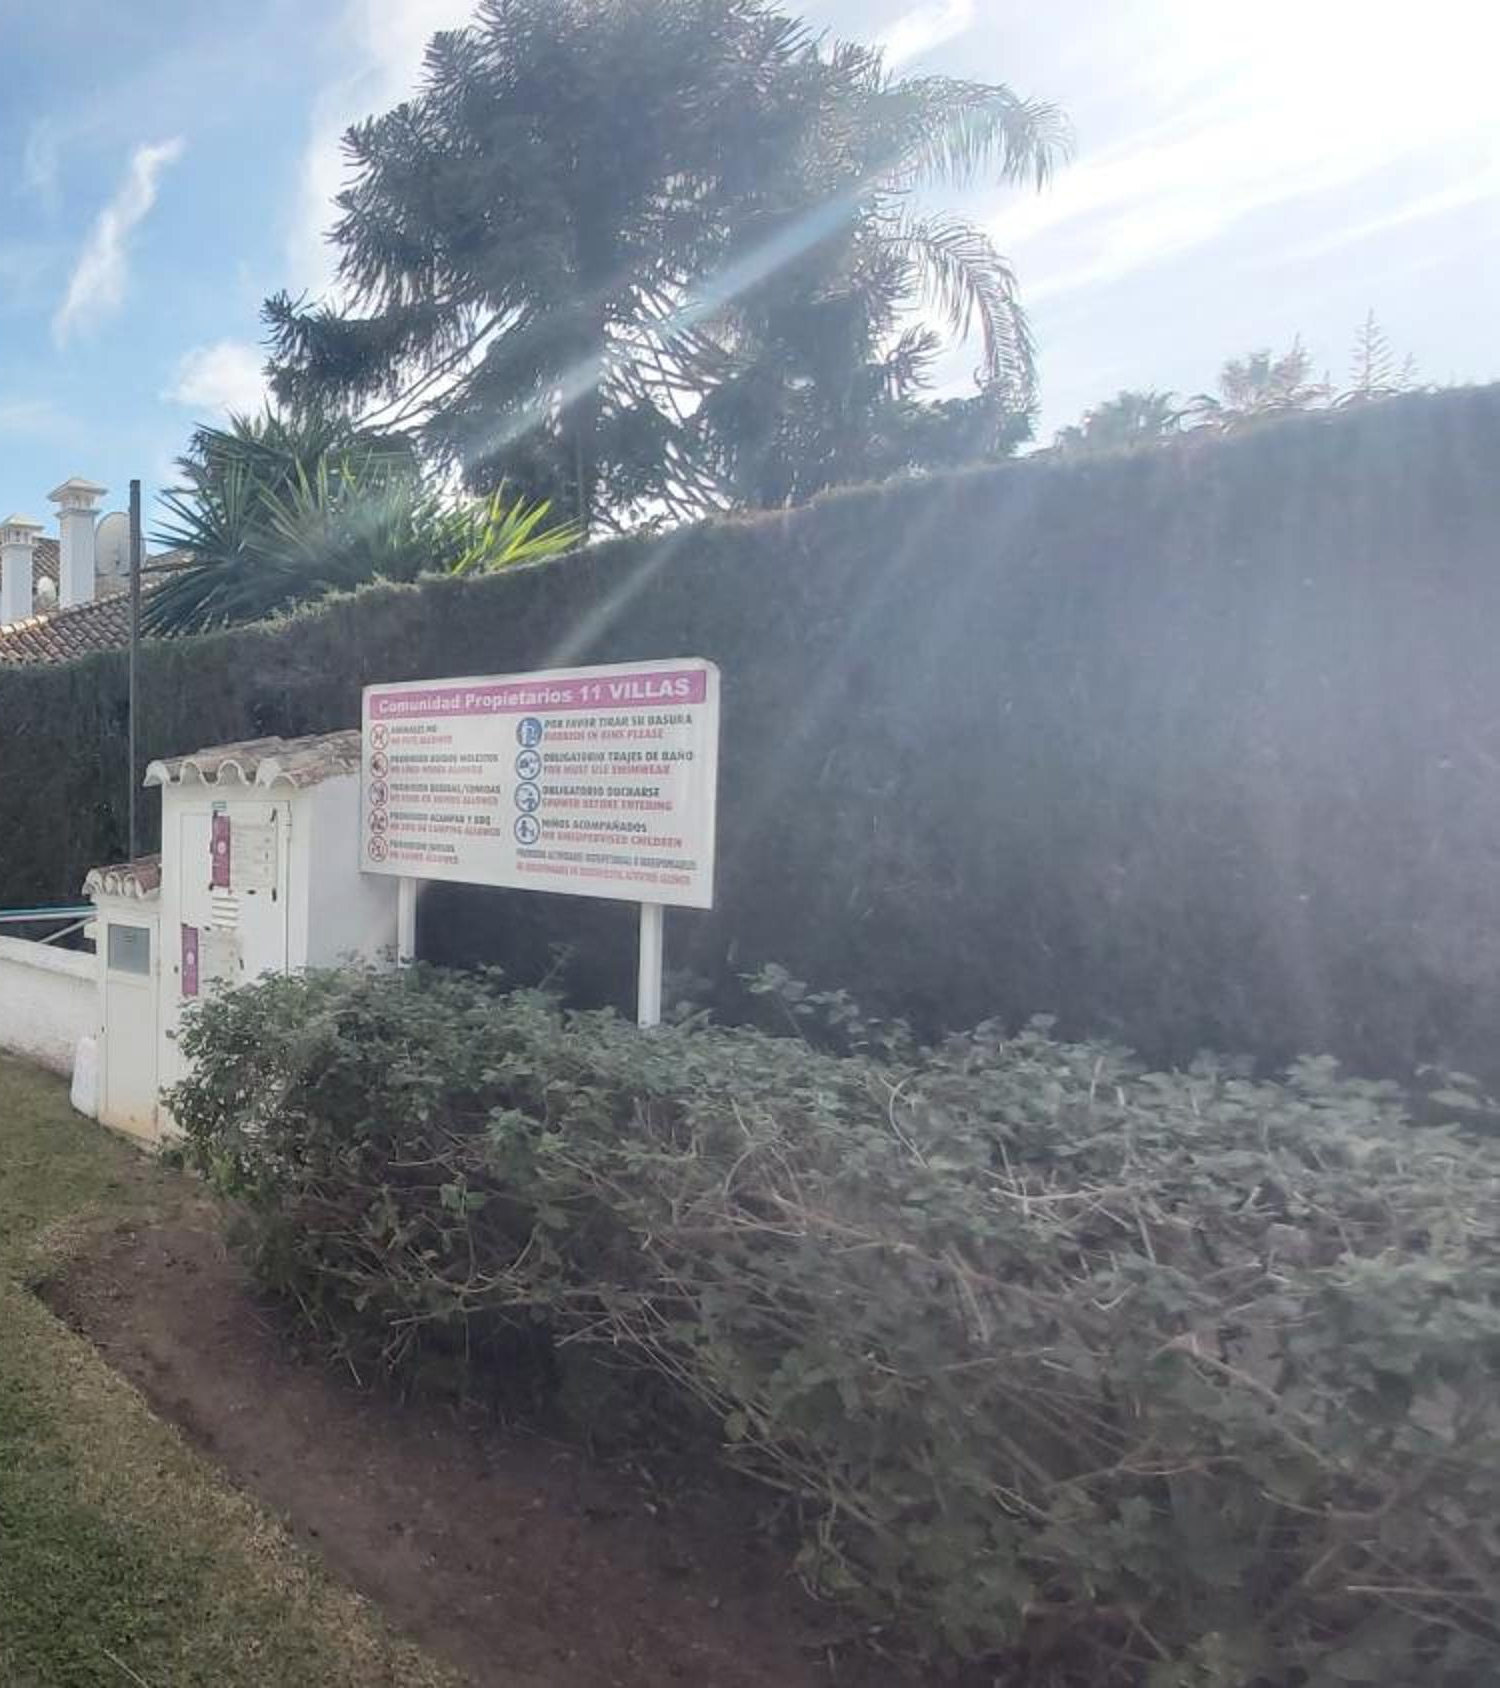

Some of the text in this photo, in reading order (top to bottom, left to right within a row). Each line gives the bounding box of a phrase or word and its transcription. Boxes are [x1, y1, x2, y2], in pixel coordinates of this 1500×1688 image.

[379, 677, 691, 714] Comunidad Propietarios 11 VILLAS
[645, 752, 658, 761] DE
